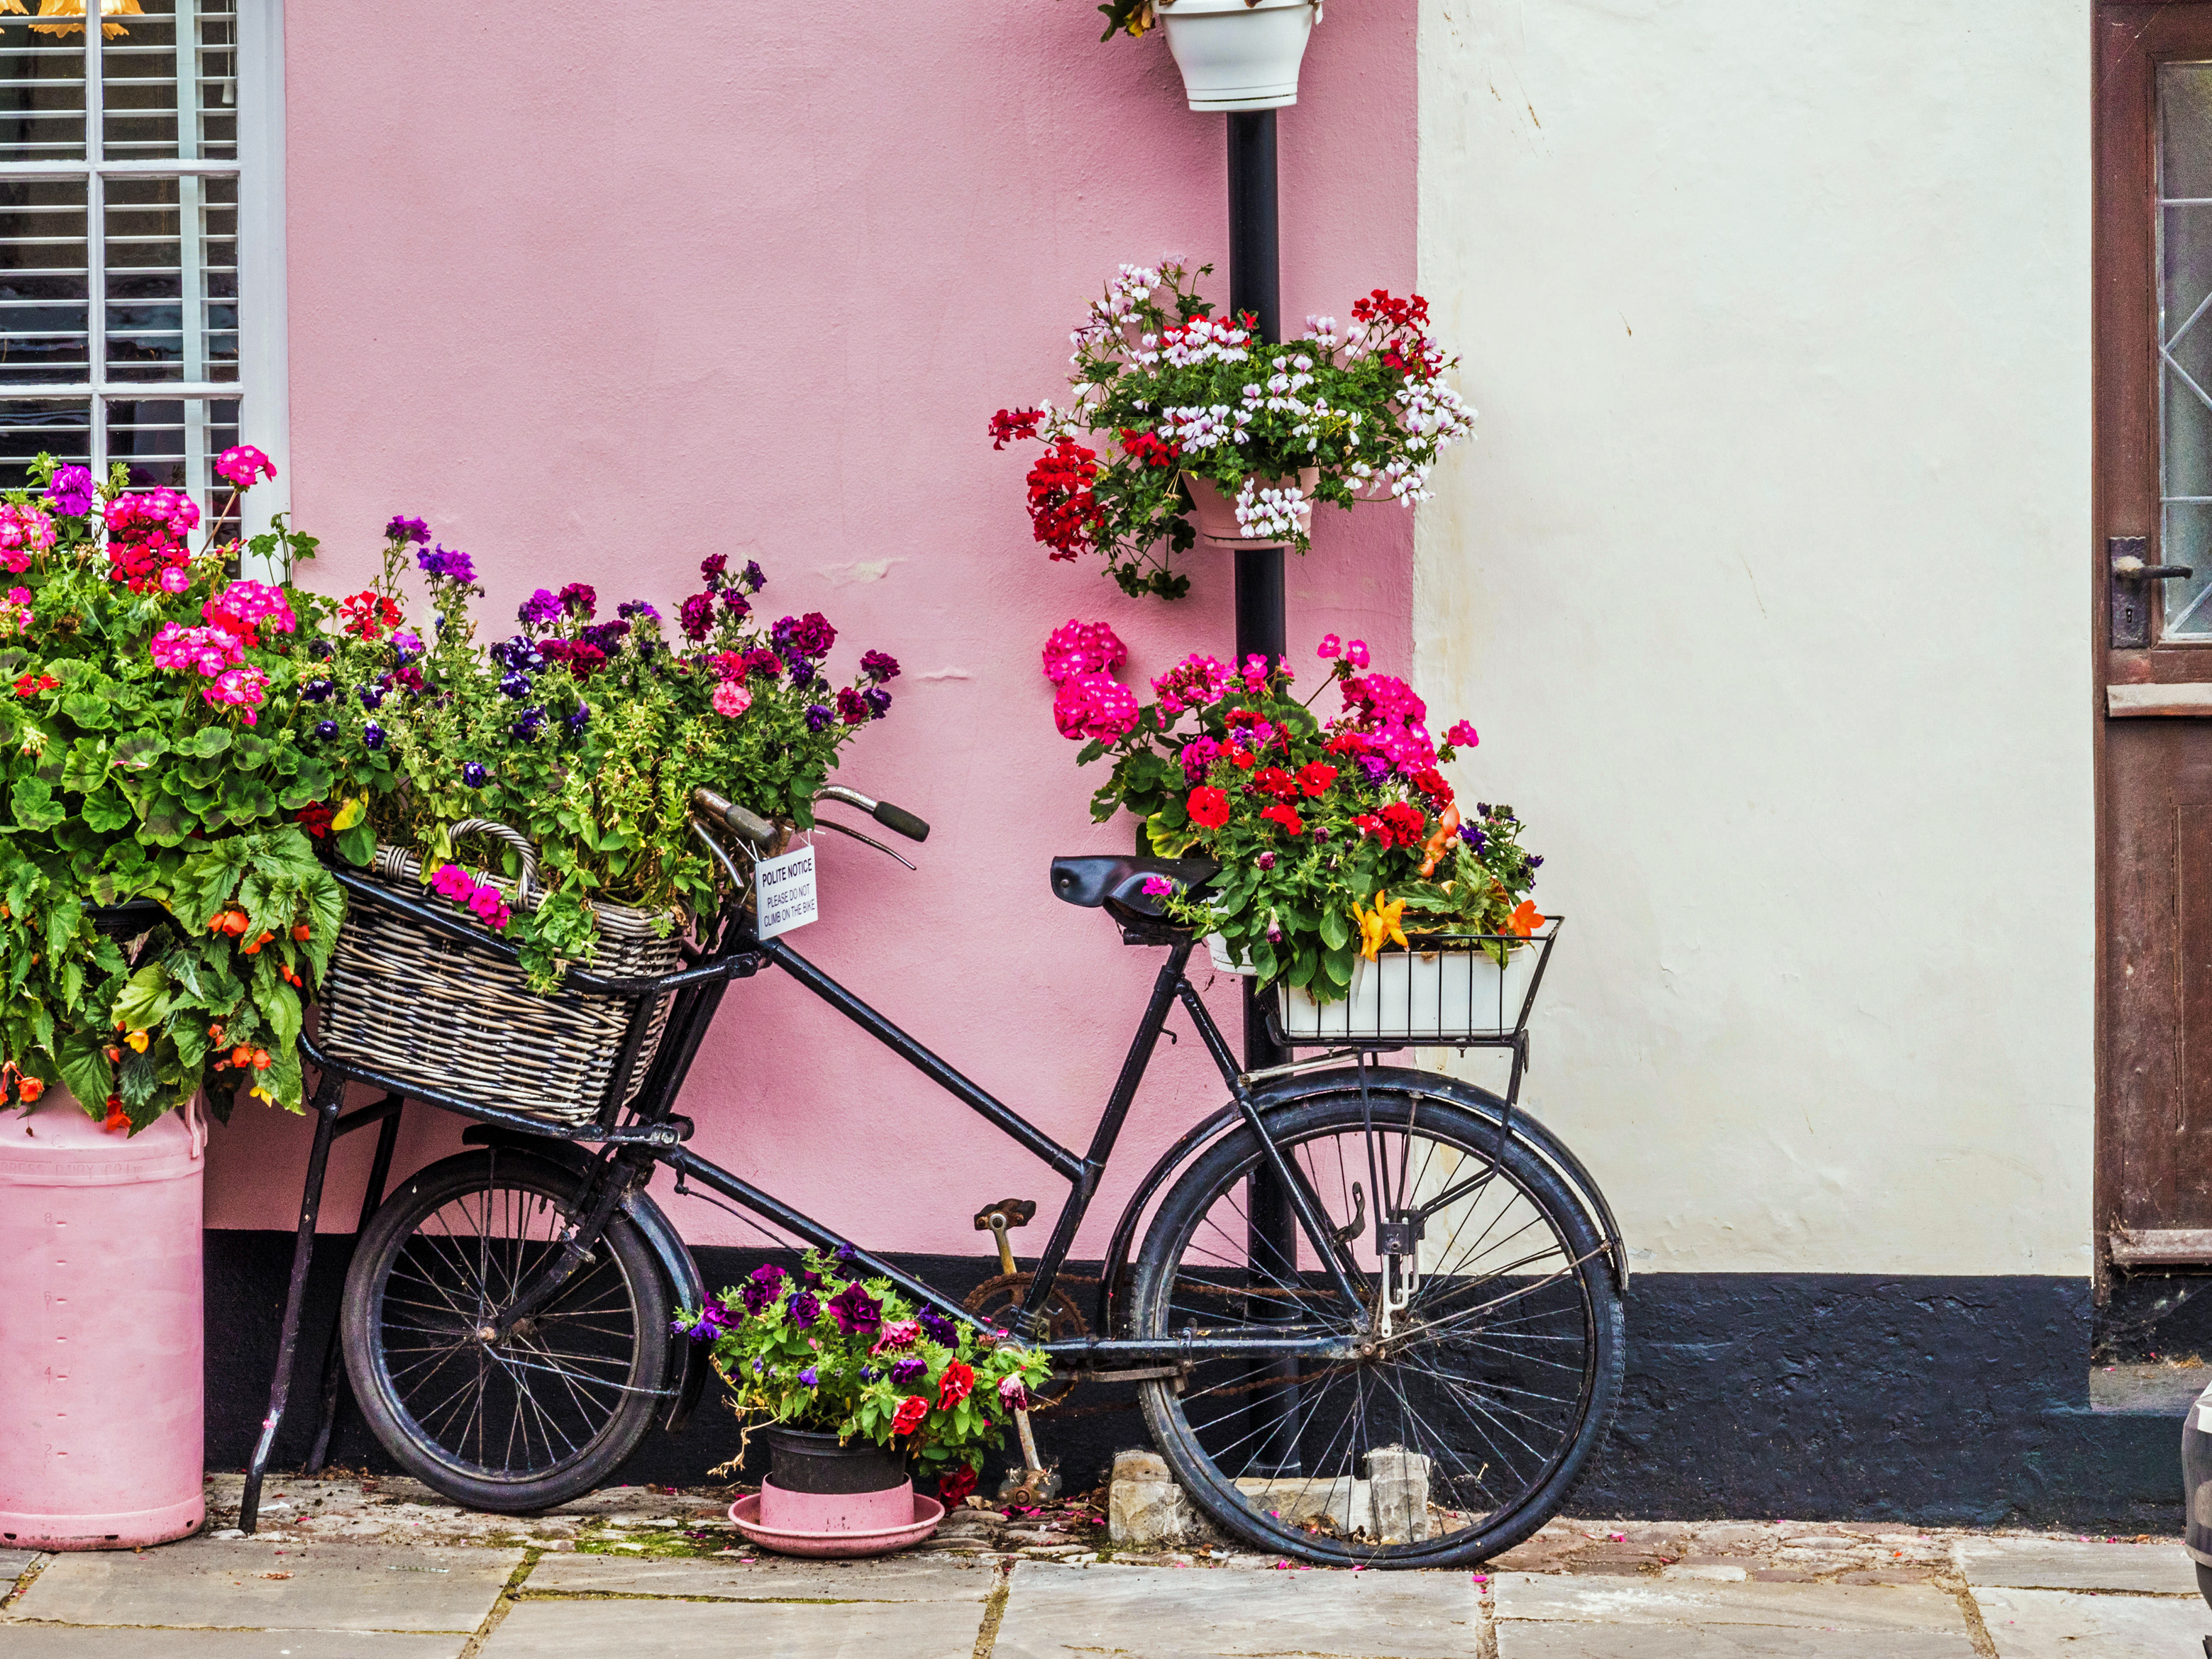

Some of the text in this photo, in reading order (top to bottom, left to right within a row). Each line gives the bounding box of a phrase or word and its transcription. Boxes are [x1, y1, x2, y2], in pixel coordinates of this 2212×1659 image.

[762, 858, 812, 887] POLITE NOTICE
[767, 883, 810, 909] PLEASE DO NOT
[763, 899, 815, 927] CLIMB ON THE BIKE
[44, 1211, 52, 1224] 8
[44, 1290, 52, 1302] 6
[44, 1366, 52, 1380] 4
[44, 1443, 52, 1456] 2
